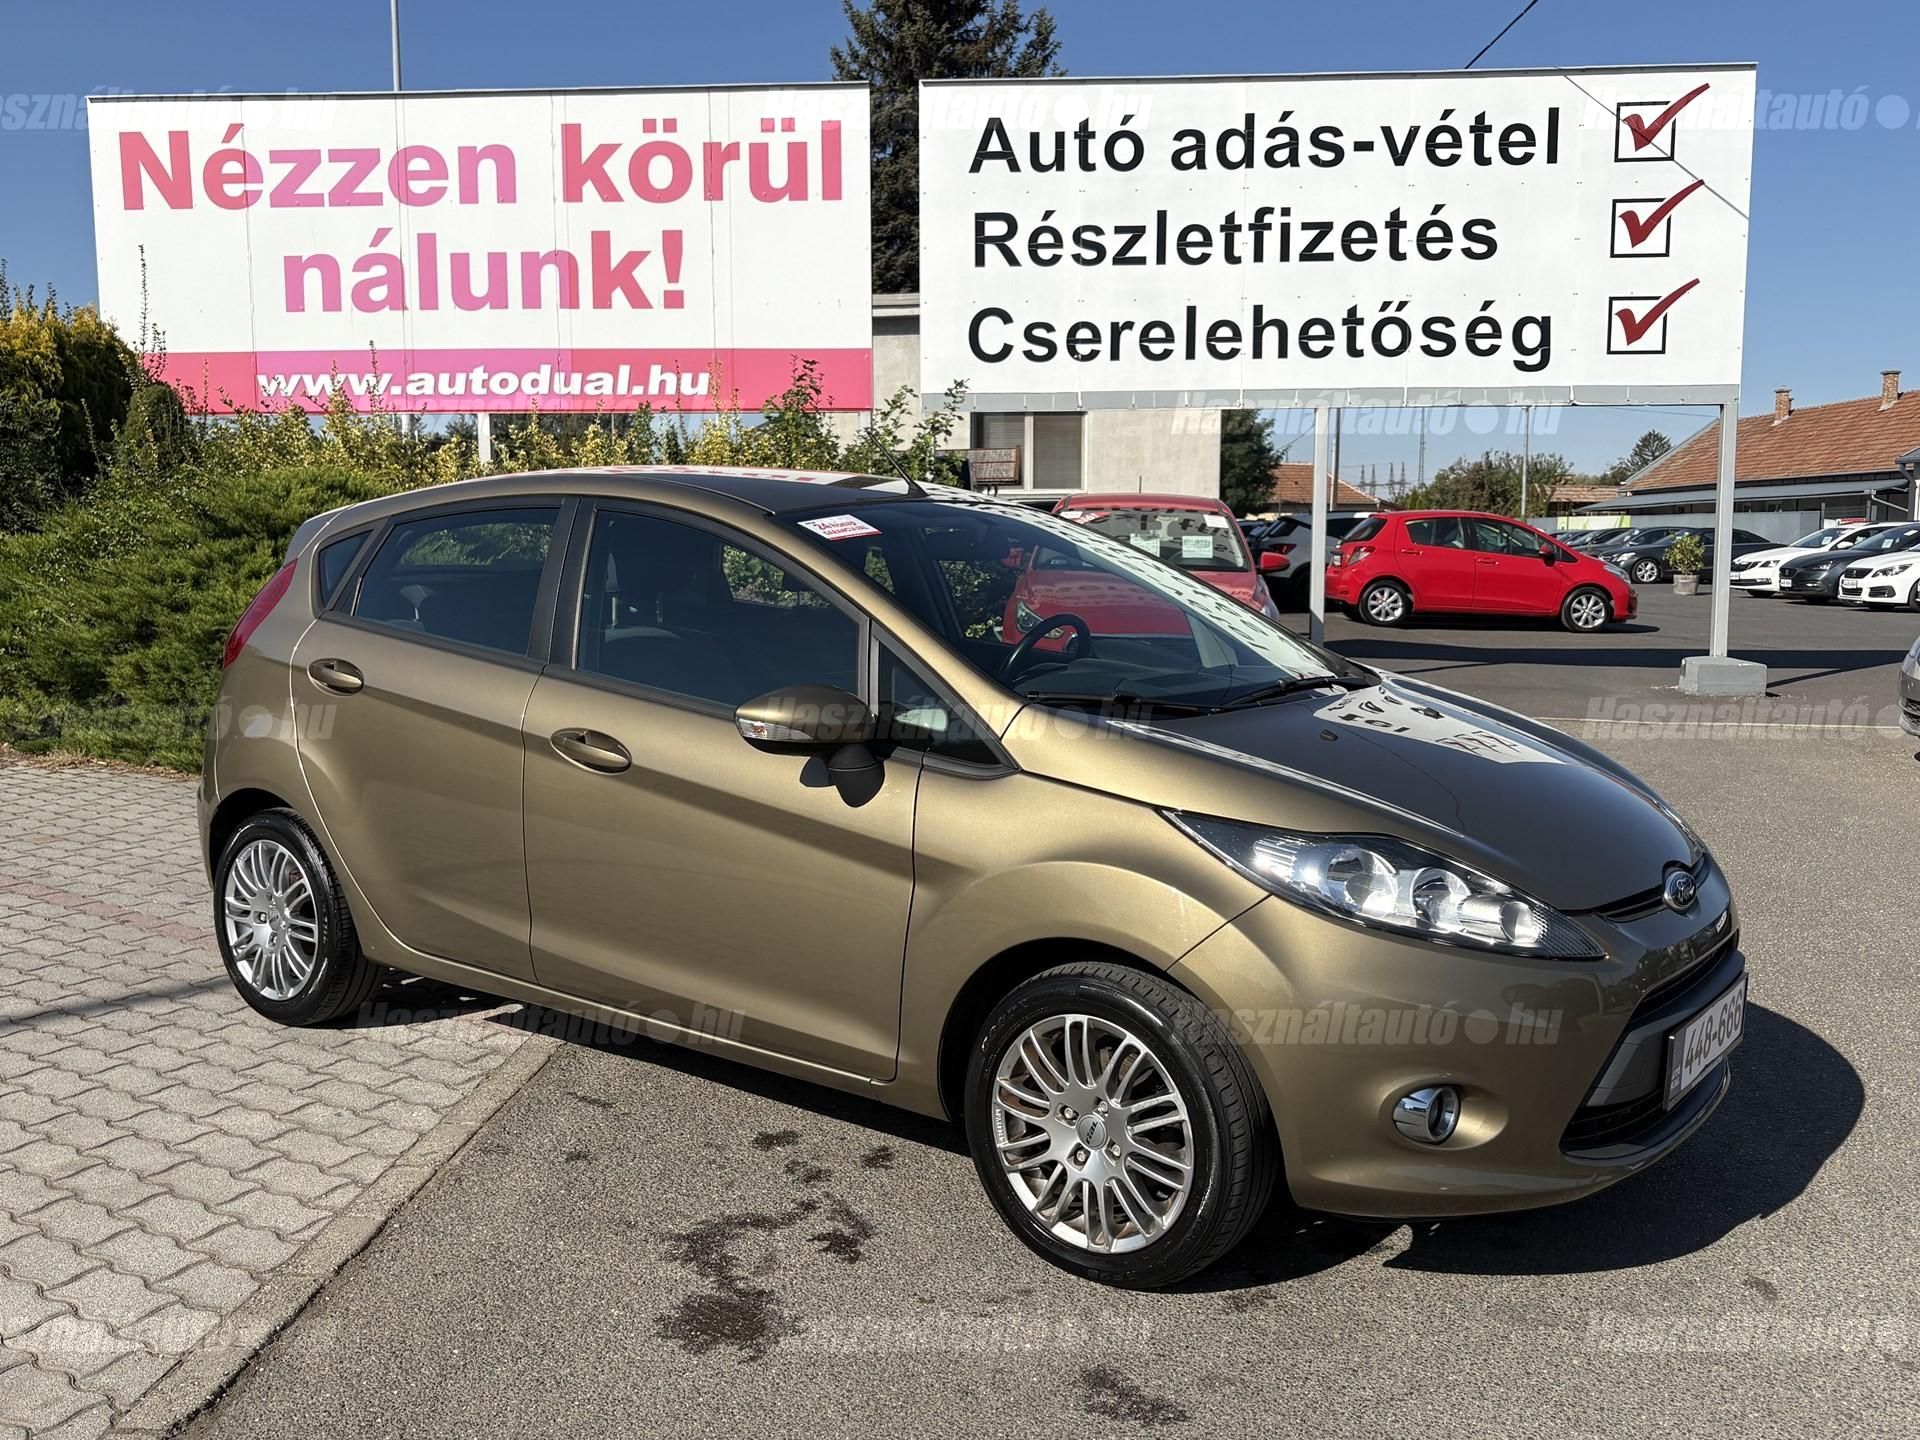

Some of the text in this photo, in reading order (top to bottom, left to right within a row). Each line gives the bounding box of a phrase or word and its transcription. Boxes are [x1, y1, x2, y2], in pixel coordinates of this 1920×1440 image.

[119, 117, 843, 211] Nézzen körül
[969, 107, 1561, 174] Autó adás-vétel
[284, 227, 684, 313] nálunk!
[973, 203, 1499, 268] Részletfizetés
[968, 299, 1552, 373] Cserelehetőség
[256, 363, 711, 397] www.autodual.hu
[1684, 988, 1744, 1076] 448-666
